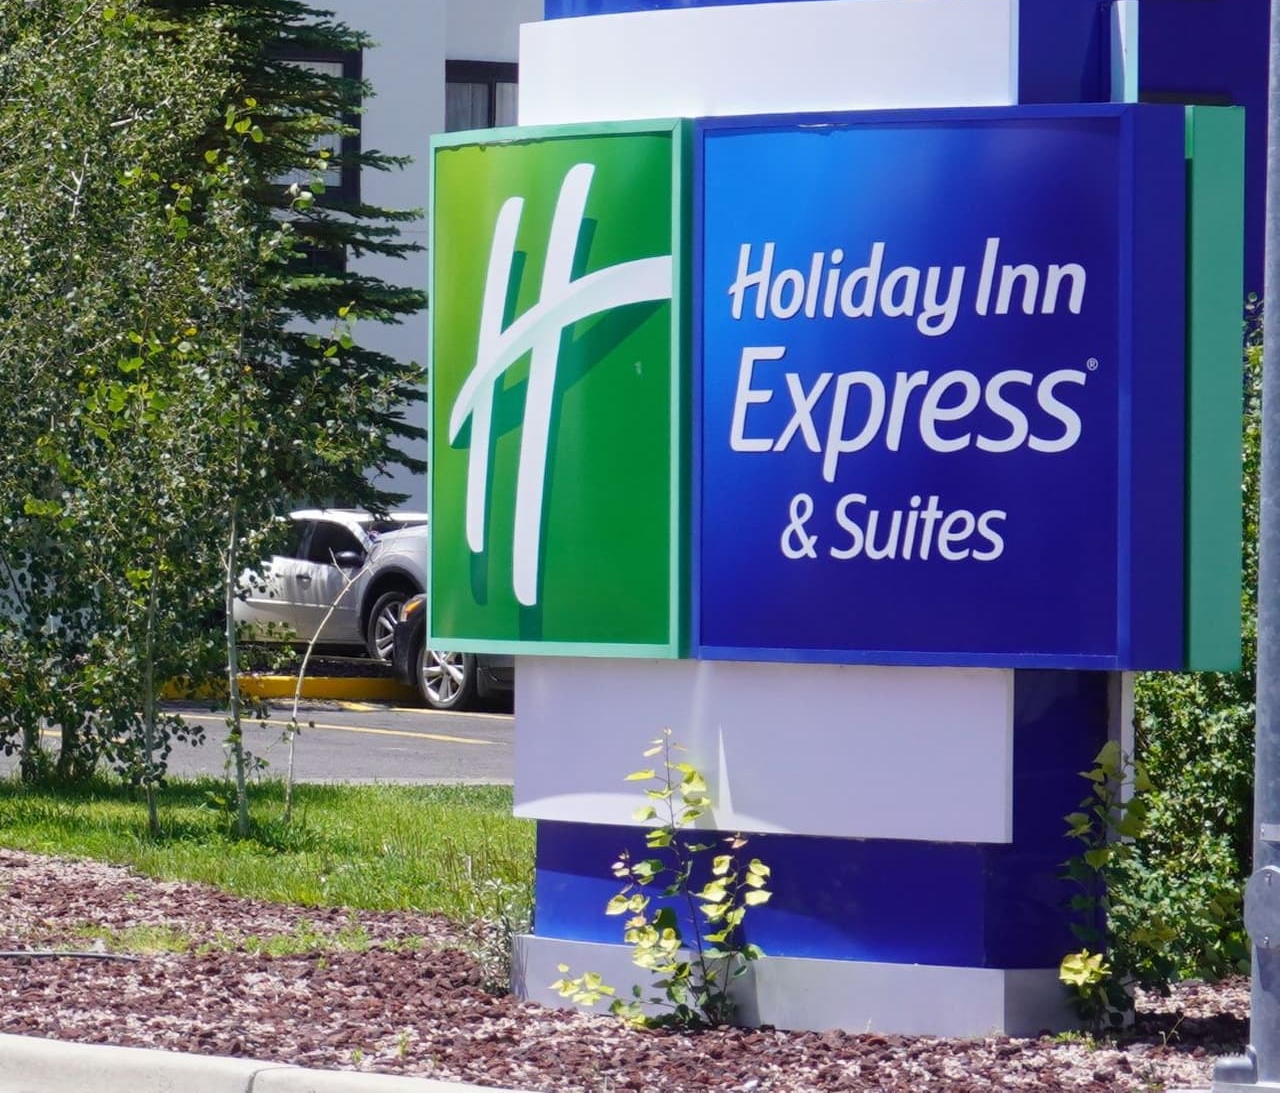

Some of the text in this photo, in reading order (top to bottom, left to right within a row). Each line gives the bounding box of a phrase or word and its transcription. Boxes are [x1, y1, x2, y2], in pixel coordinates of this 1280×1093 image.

[728, 237, 1087, 337] Holiday Inn
[780, 492, 1008, 562] & Suites
